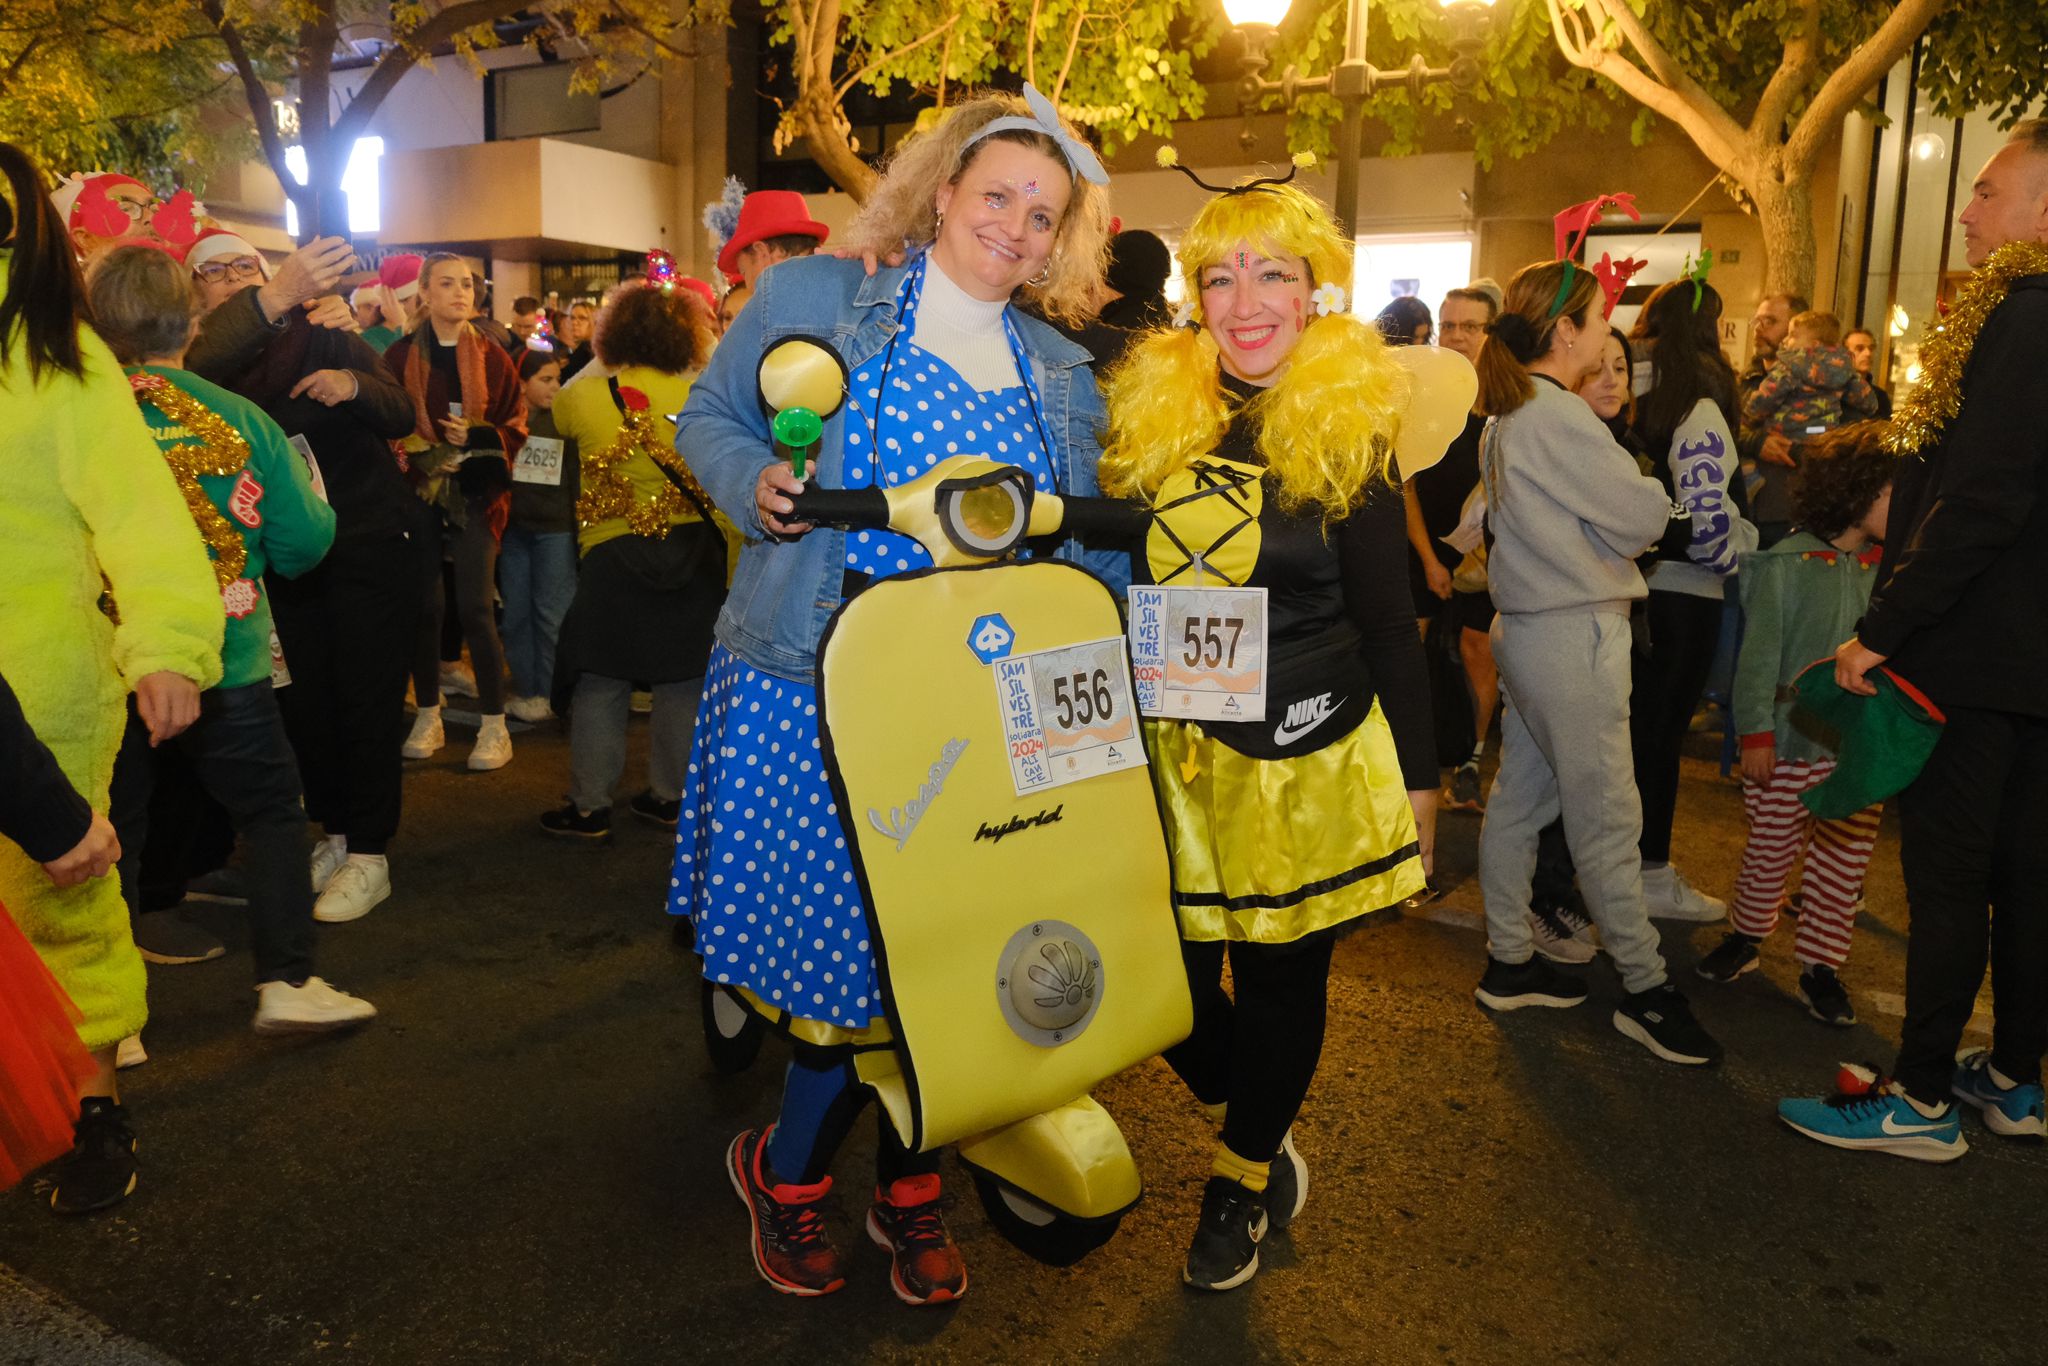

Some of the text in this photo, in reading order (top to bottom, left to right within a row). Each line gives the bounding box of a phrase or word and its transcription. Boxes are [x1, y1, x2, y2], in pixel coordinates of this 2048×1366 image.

[524, 446, 558, 468] 2625
[1136, 590, 1162, 607] SAN
[1139, 624, 1160, 640] VES
[1137, 641, 1160, 656] TRE
[1183, 616, 1244, 669] 557
[1000, 662, 1025, 681] SAN
[1133, 666, 1163, 681] 2024
[1138, 681, 1155, 691] ALI
[1009, 695, 1031, 712] VES
[1053, 668, 1113, 730] 556
[1139, 700, 1157, 709] TE
[1284, 692, 1332, 728] NIKE
[1011, 712, 1035, 729] TRE
[1009, 727, 1042, 742] solidaria
[1011, 738, 1044, 758] 2024
[1021, 755, 1039, 768] ALI
[1024, 765, 1043, 778] CAN
[1027, 772, 1046, 784] TE
[867, 737, 970, 852] Vespa
[973, 803, 1064, 844] hybrid
